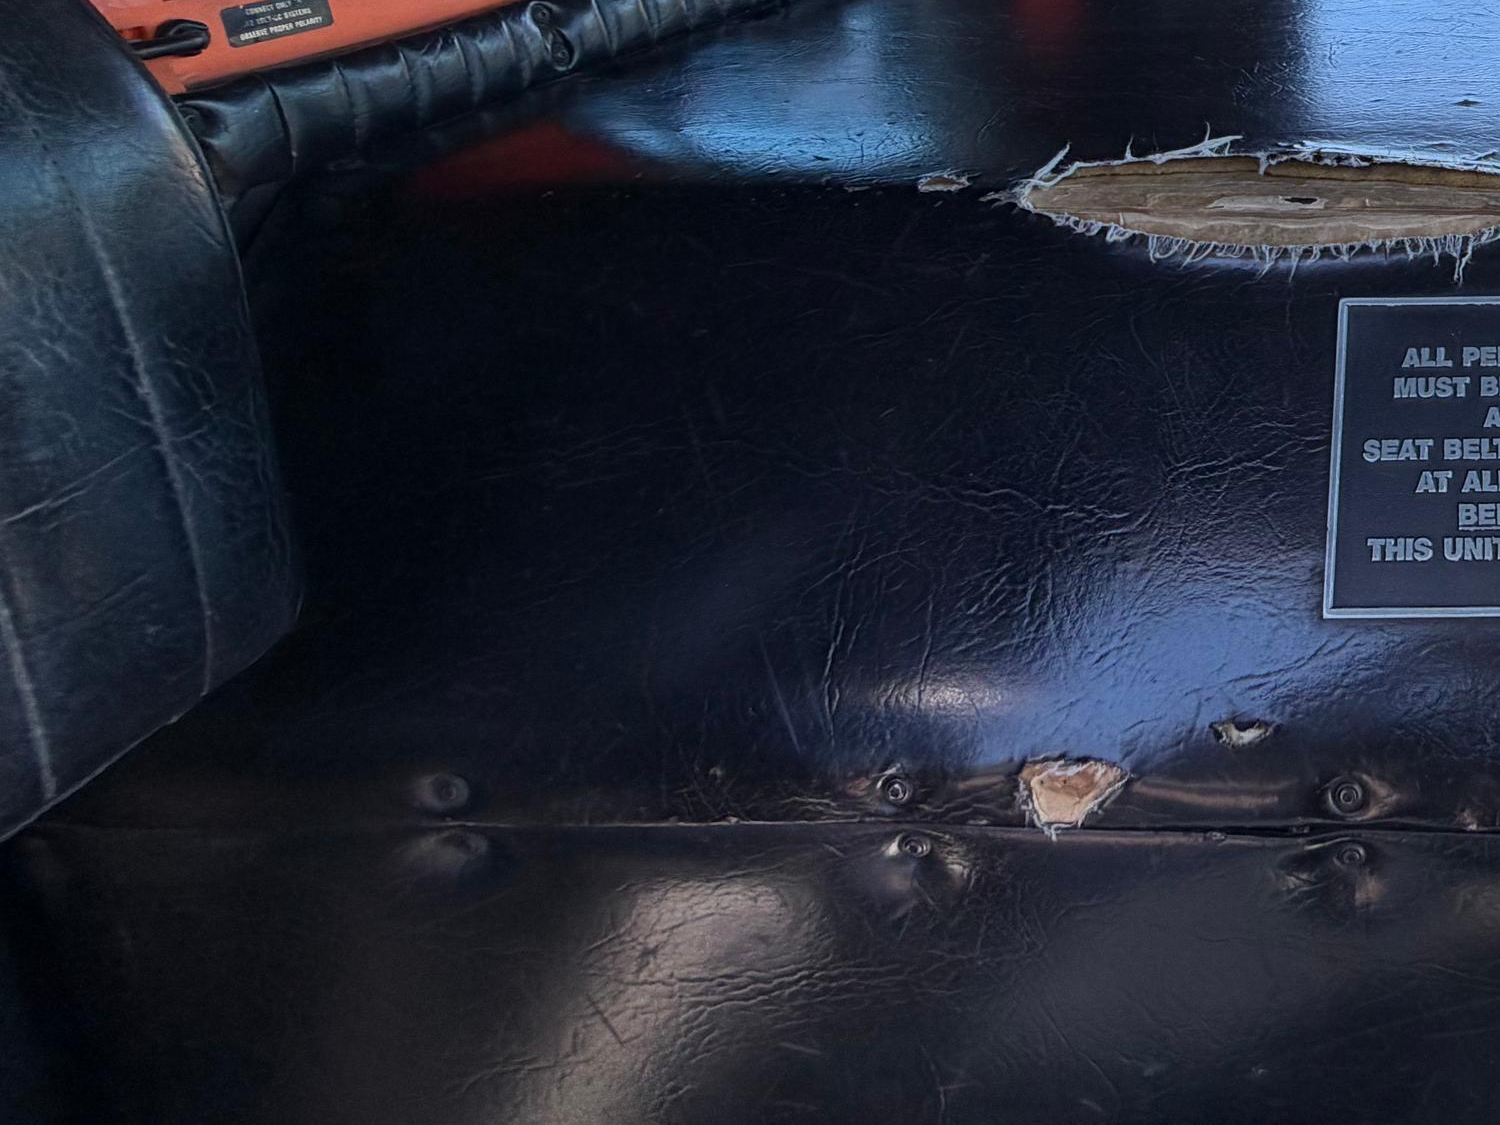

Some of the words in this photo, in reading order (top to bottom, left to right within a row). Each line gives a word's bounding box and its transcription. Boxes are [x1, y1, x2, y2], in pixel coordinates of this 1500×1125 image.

[269, 22, 294, 35] PROPER
[295, 16, 323, 28] POLARITY
[1401, 346, 1453, 368] ALL
[1393, 377, 1469, 399] MUST
[1362, 438, 1434, 461] SEAT
[1414, 471, 1452, 494] AT
[1367, 538, 1433, 561] THIS
